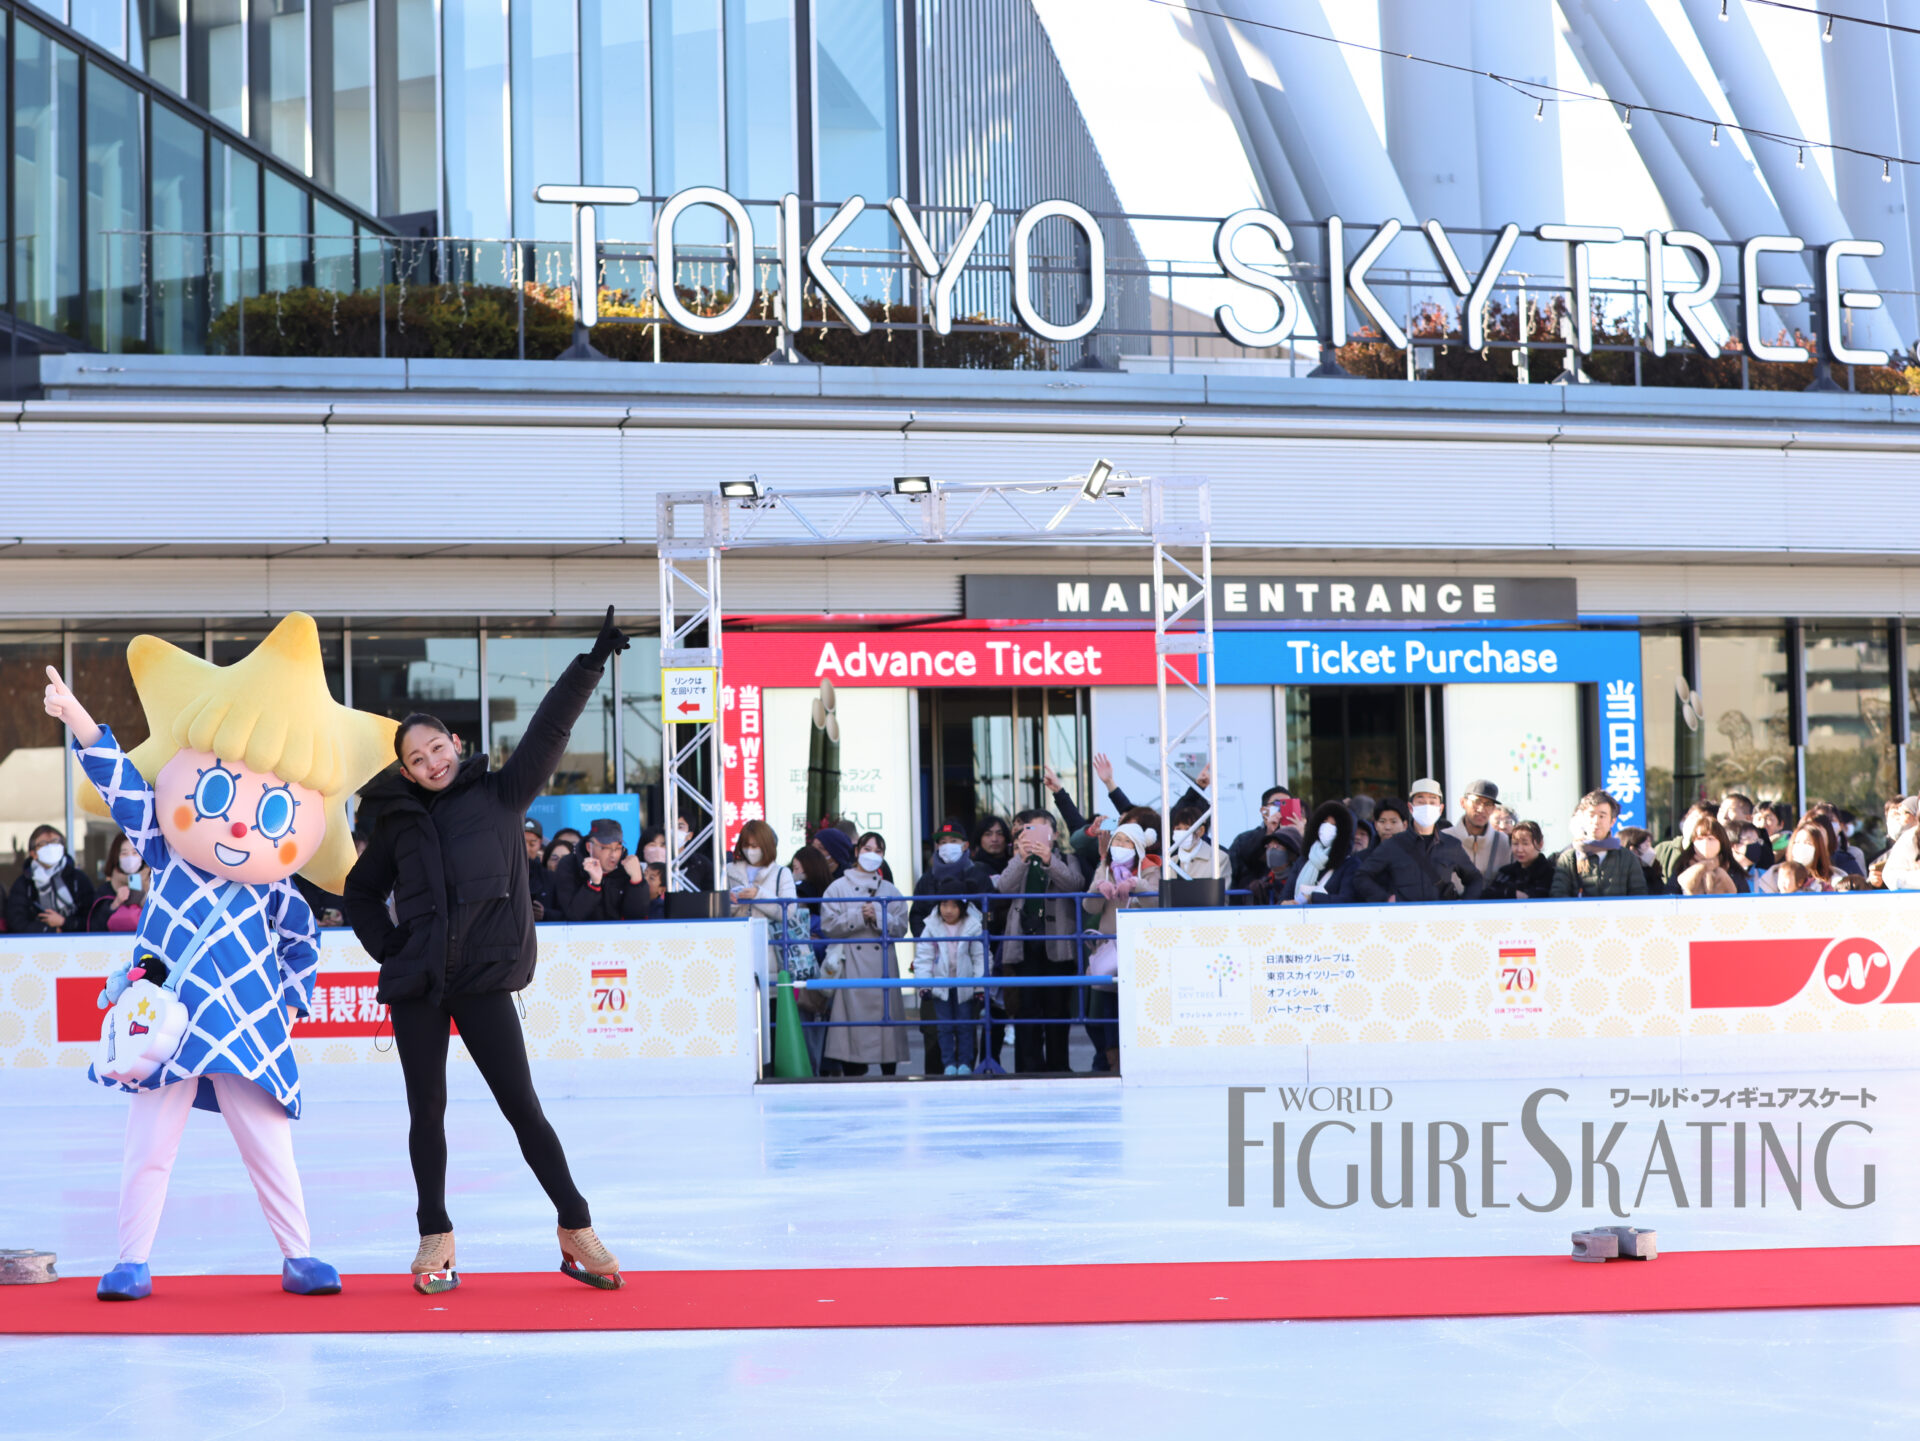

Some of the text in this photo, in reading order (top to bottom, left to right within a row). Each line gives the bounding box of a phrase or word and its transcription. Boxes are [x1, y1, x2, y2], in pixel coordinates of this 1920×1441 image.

[534, 185, 1889, 366] TOKYO SKYTREE
[1057, 582, 1496, 613] MAIN ENTRANCE
[814, 641, 1102, 677] Advance Ticket
[1287, 640, 1558, 674] Ticket Purchase
[671, 687, 708, 695] 左回りです
[675, 677, 702, 686] リンクは
[722, 684, 741, 851] 前売券
[580, 802, 630, 812] TOKYO SKYTREE
[284, 985, 392, 1024] 清製粉
[1267, 987, 1319, 998] オフィシャル
[1267, 1003, 1336, 1014] パートナーです。
